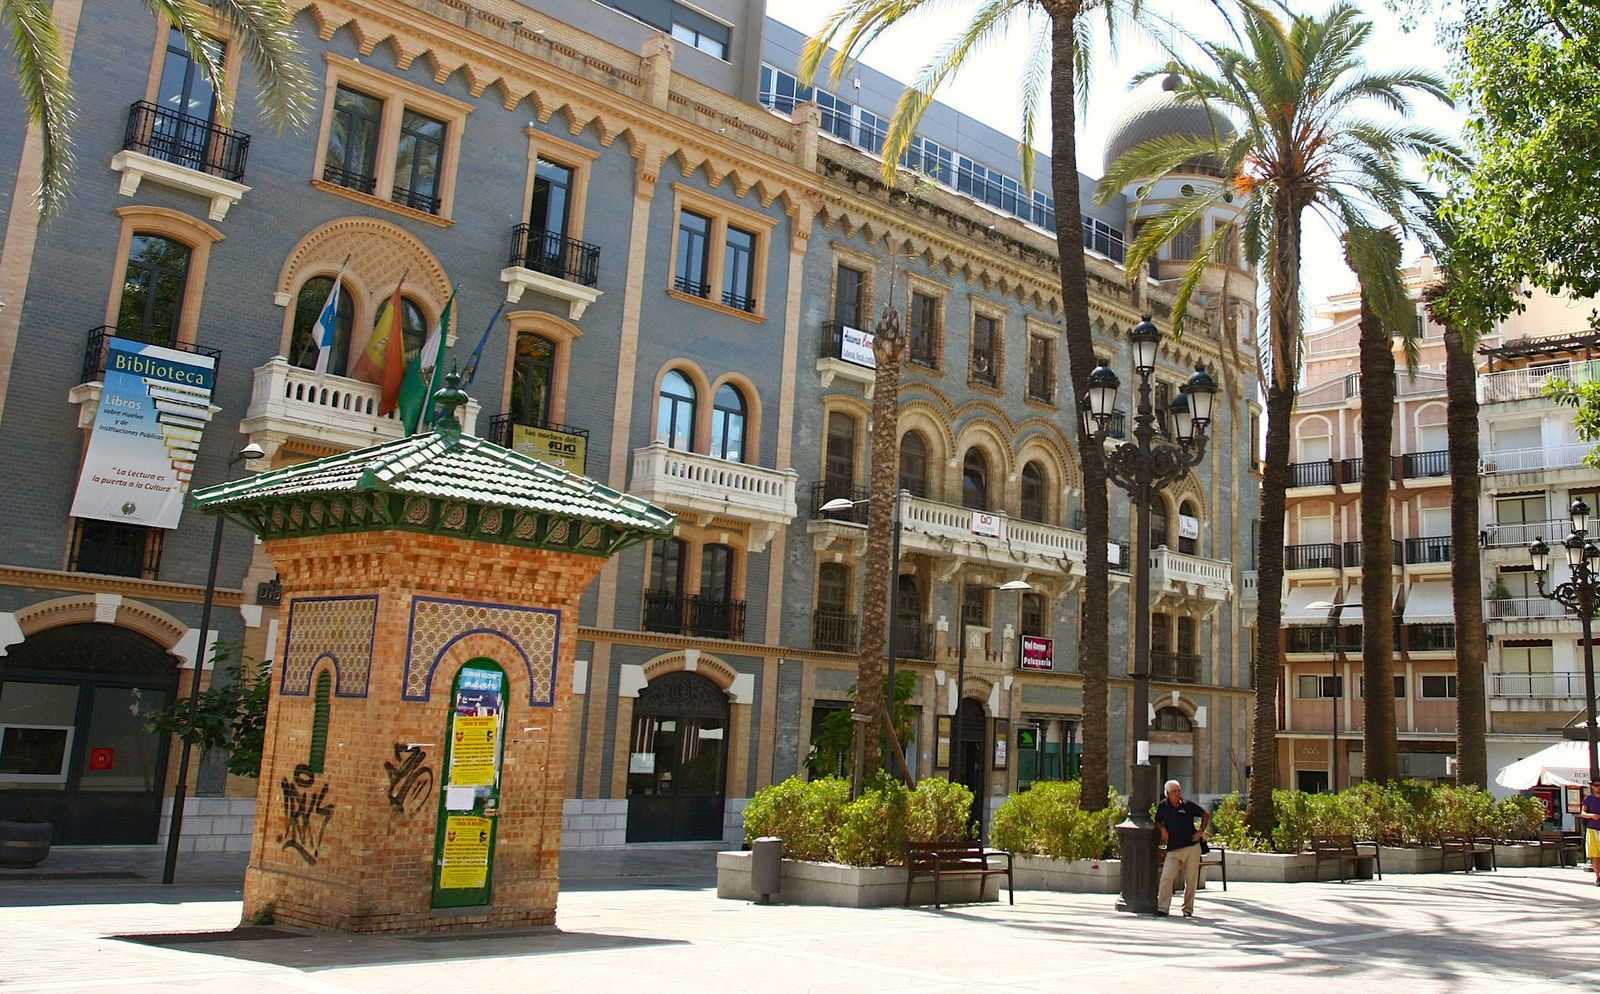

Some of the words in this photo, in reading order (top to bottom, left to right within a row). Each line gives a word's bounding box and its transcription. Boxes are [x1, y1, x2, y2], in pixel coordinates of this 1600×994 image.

[116, 354, 204, 385] Biblioteca
[105, 394, 142, 410] Libros
[103, 408, 121, 416] sobre
[122, 411, 144, 420] Huelva
[99, 425, 138, 437] Instituciones
[537, 431, 563, 441] noches
[127, 470, 156, 480] Lectura
[100, 477, 127, 487] puerta
[135, 481, 143, 489] la
